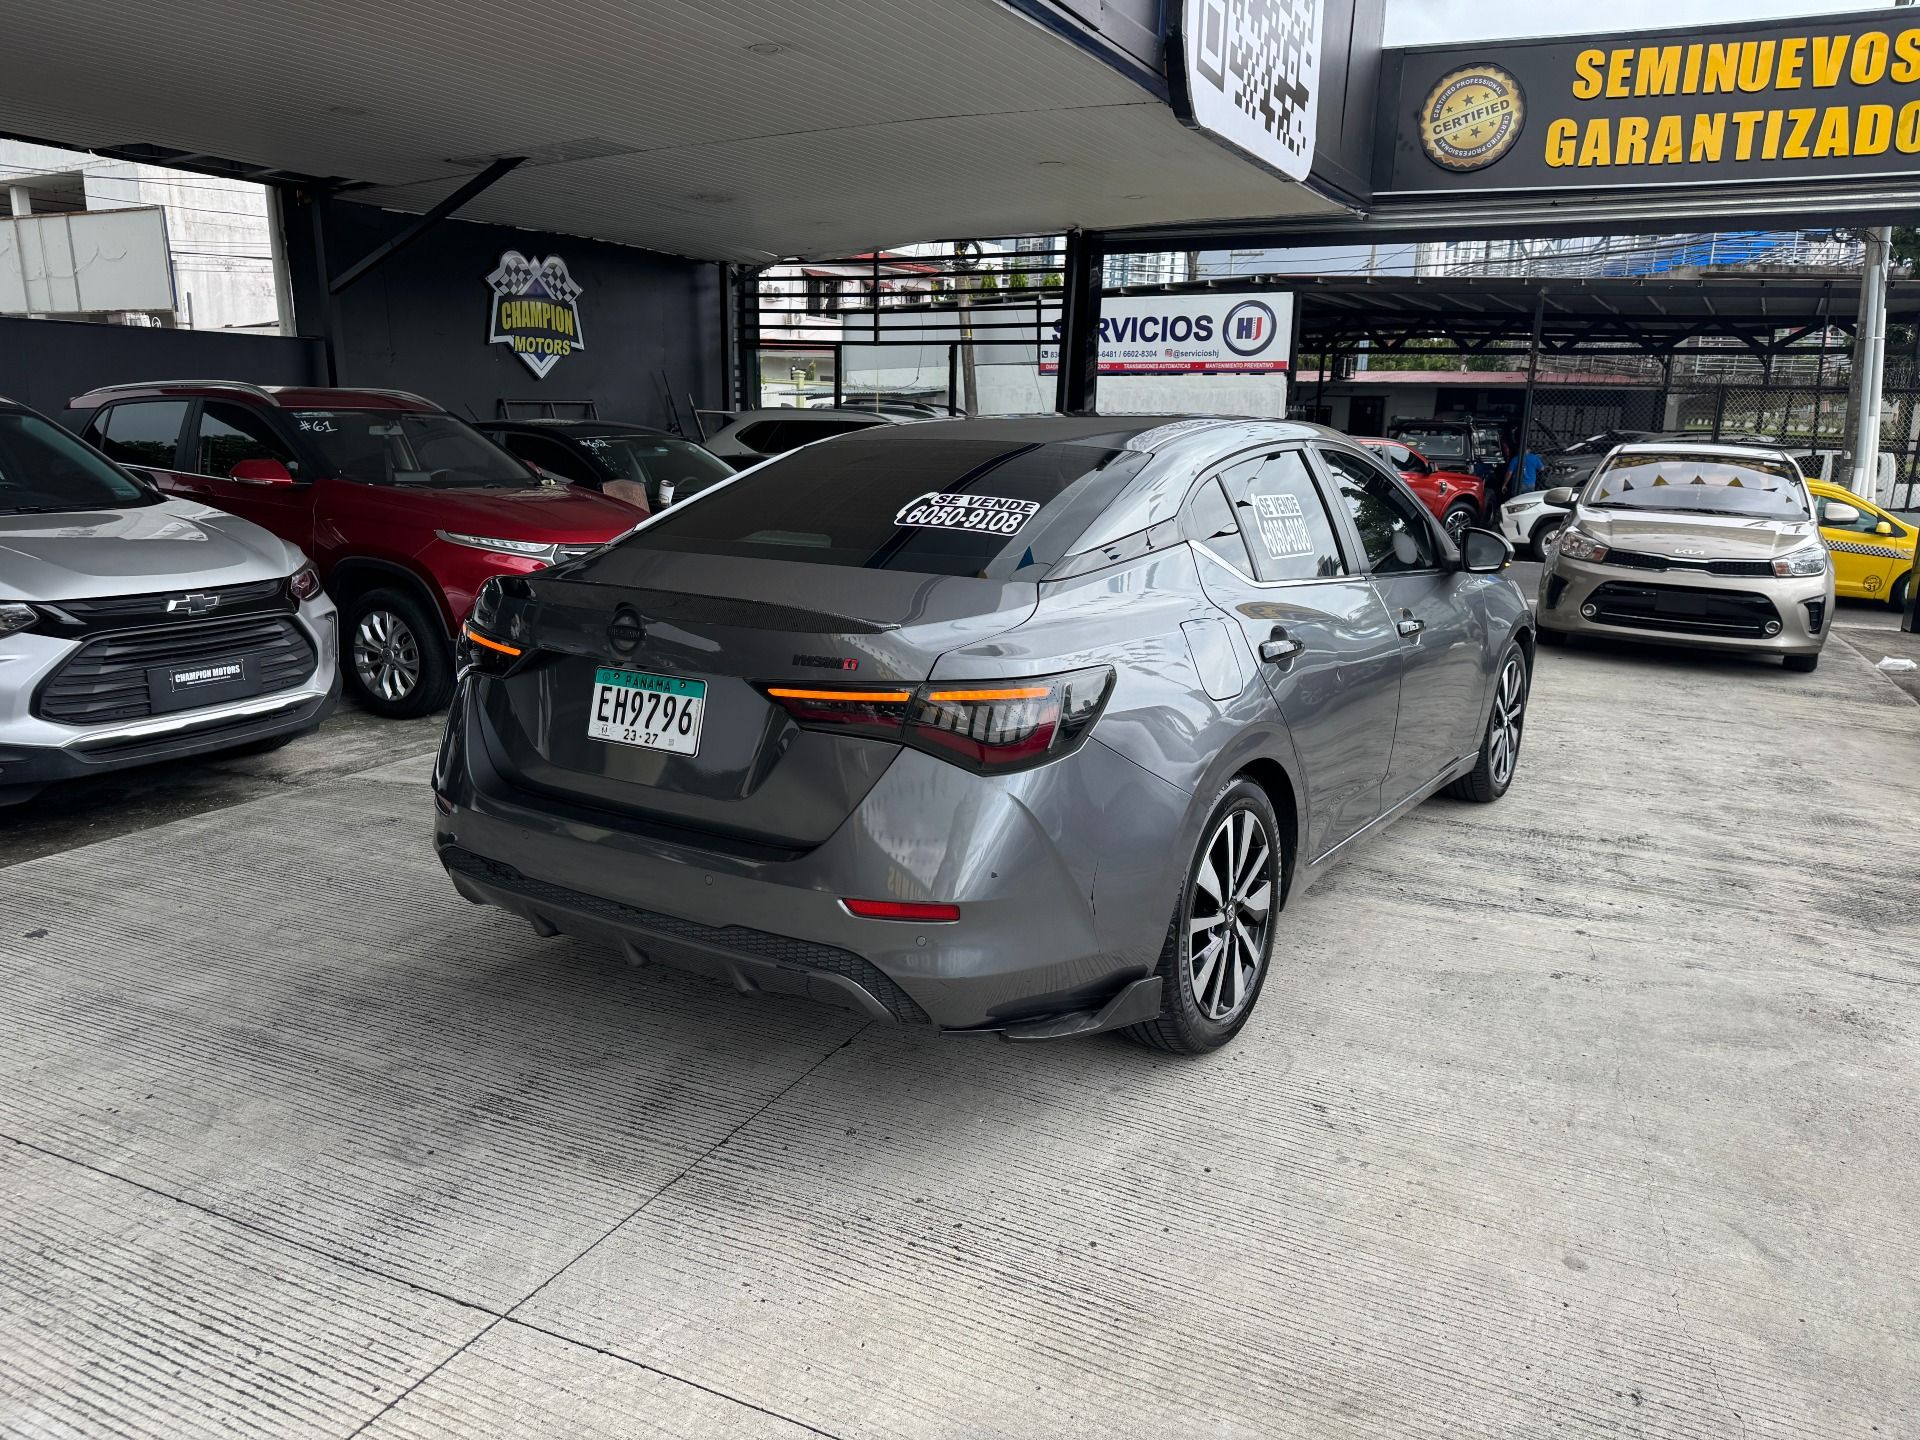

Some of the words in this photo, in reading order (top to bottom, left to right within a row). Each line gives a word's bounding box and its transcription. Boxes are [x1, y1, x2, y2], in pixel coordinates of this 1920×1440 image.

[1571, 28, 1920, 99] SEMINUEVOS
[1433, 87, 1457, 118] CERTIFIED
[1456, 78, 1503, 95] PROFESSIONAL
[1433, 100, 1510, 135] CERTIFIED
[1486, 115, 1510, 148] CERTIFIED
[1544, 100, 1920, 168] GARANTIZADO
[1438, 139, 1486, 157] PROFESSIONAL
[501, 301, 574, 336] CHAMPION
[1236, 317, 1263, 340] HJ
[514, 335, 571, 356] MOTORS
[1122, 350, 1157, 358] 6602-8304
[1173, 349, 1219, 358] @servicioshj
[299, 420, 338, 432] #61
[934, 495, 961, 505] SE
[967, 497, 1036, 513] VENDE
[1258, 497, 1273, 516] SE
[1269, 496, 1300, 515] VENDE
[906, 505, 1023, 533] 6050-9108
[175, 669, 212, 683] CHAMPION
[212, 665, 240, 677] MOTORS
[625, 675, 671, 693] PANAMA
[597, 685, 693, 735] EH9796
